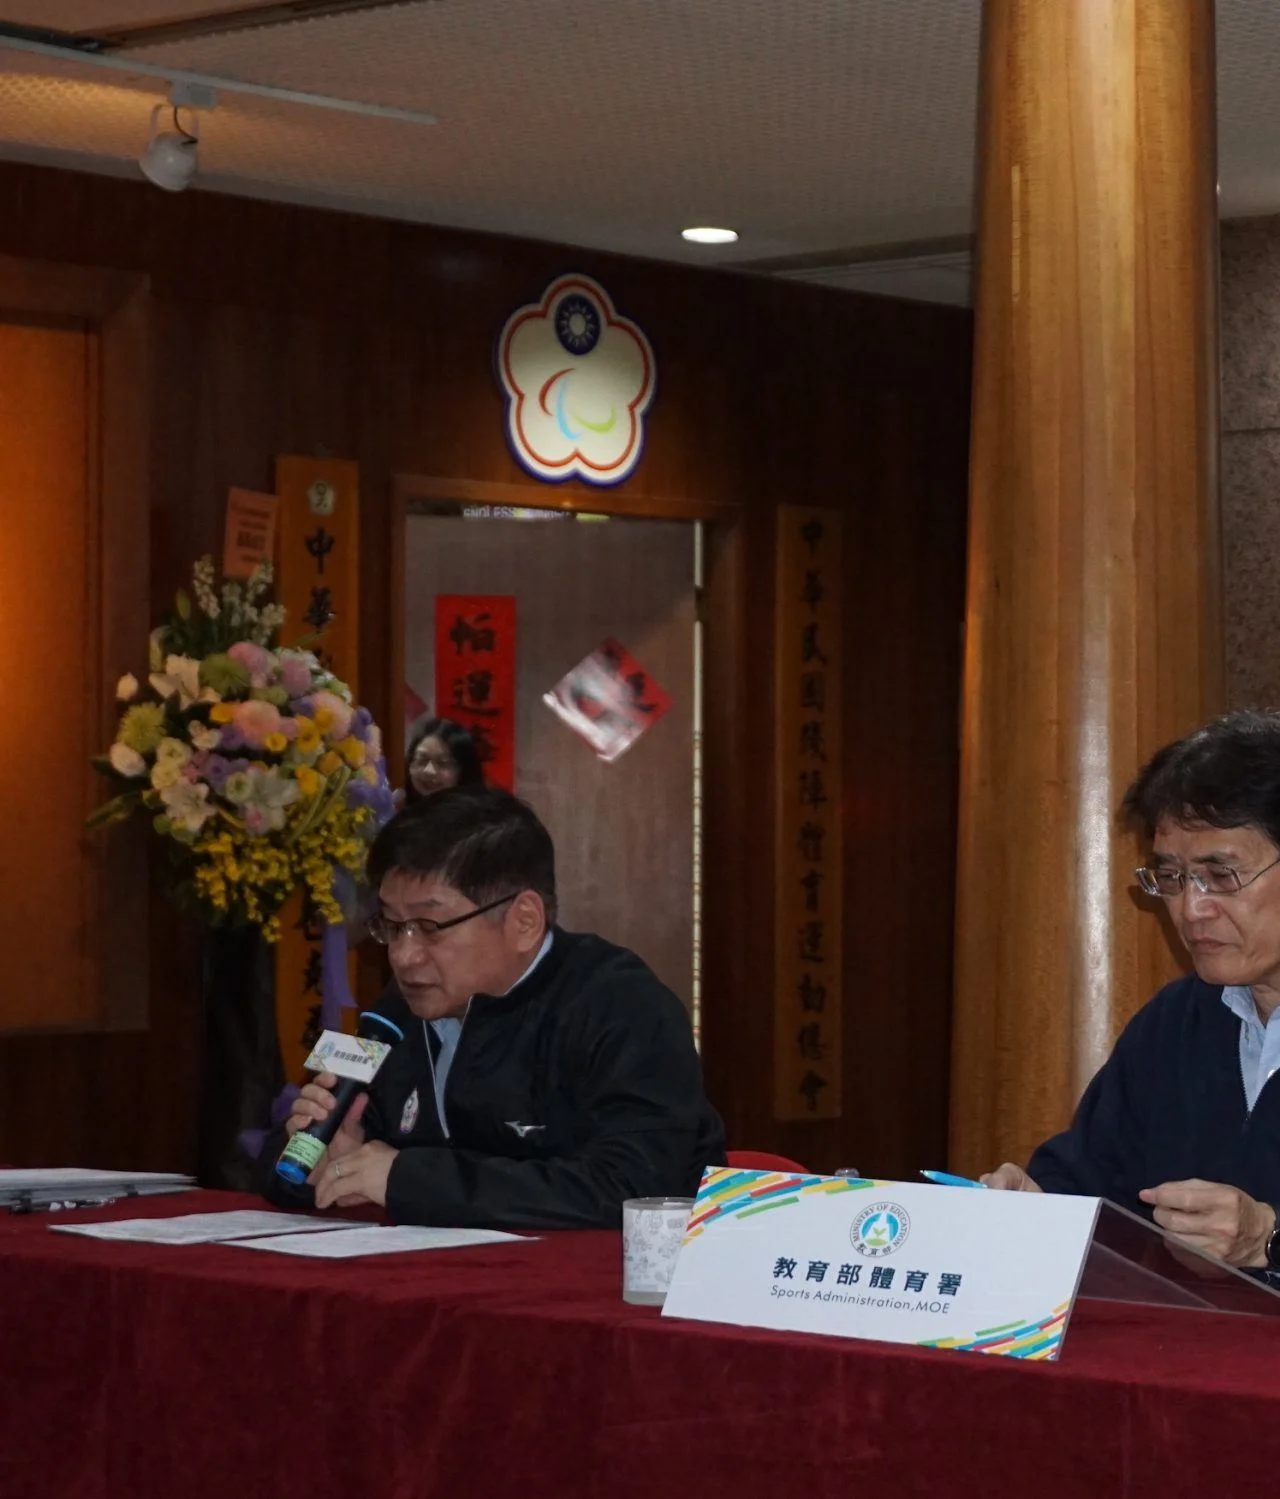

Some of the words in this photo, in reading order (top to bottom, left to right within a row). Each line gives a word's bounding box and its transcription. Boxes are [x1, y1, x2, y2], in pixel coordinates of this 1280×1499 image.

[852, 1206, 876, 1243] MINISTRY
[876, 1203, 889, 1212] OF
[889, 1203, 909, 1248] EDUCATION
[770, 1284, 811, 1300] Sports
[772, 1256, 963, 1298] 教育部體育署
